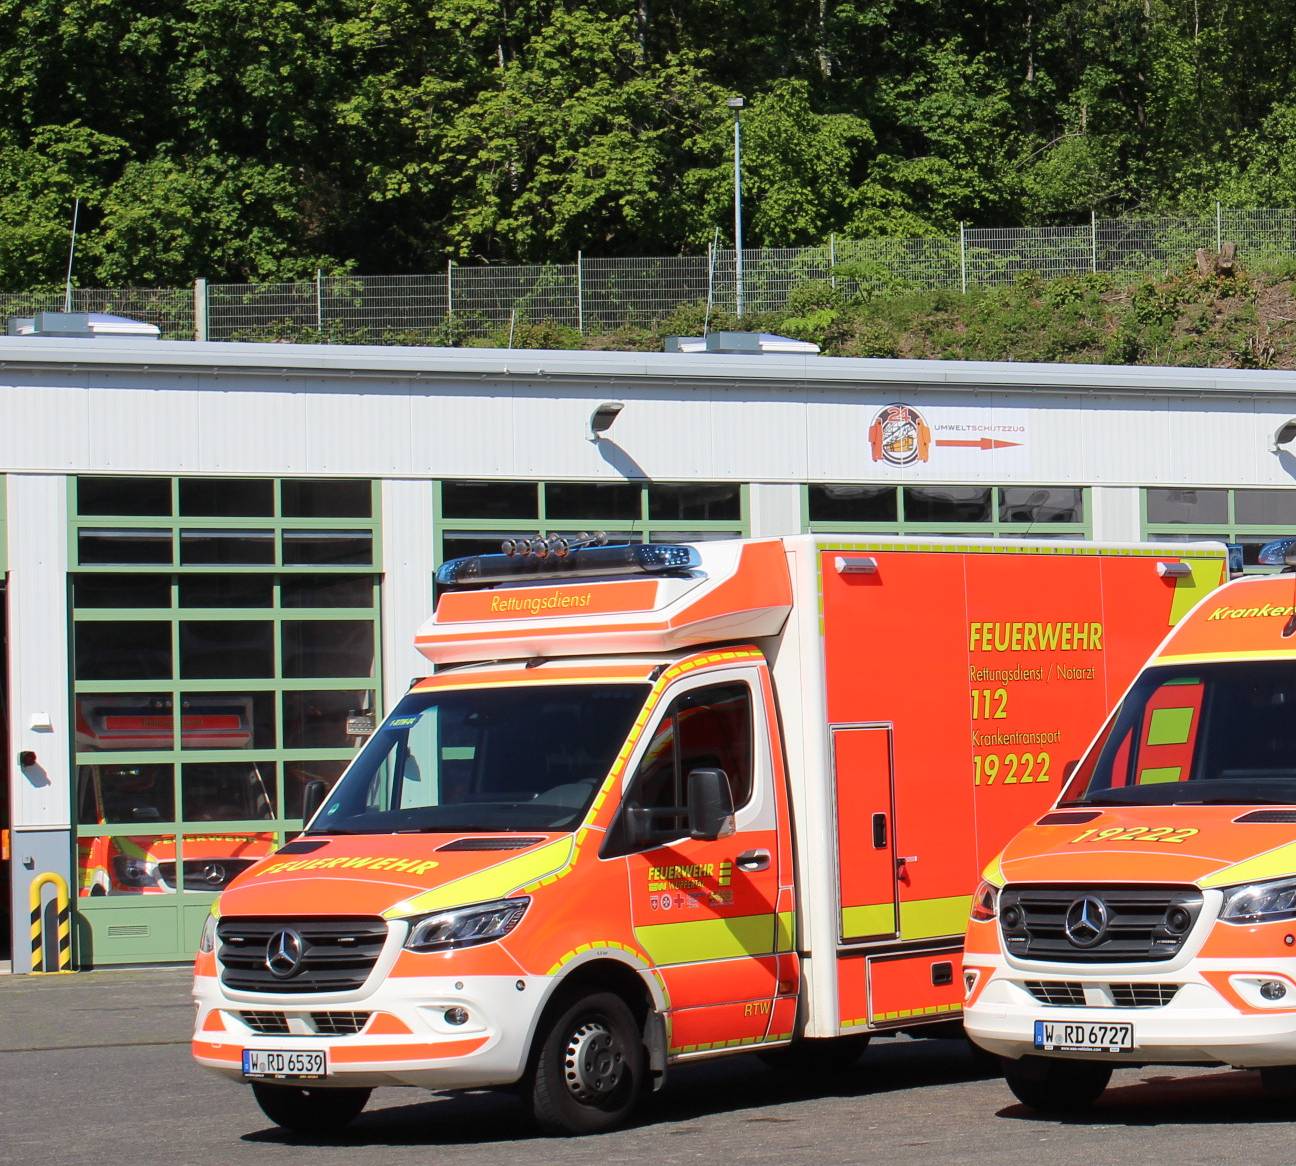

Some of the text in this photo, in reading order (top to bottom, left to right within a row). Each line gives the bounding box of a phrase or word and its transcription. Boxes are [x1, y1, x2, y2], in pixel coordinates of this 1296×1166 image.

[887, 407, 911, 422] 24
[491, 591, 592, 614] Rettungsdienst
[969, 622, 1103, 652] FEUERWEHR
[969, 664, 1043, 685] Rettungsdienst
[1056, 664, 1095, 680] Notarzt
[971, 688, 1008, 719] 112
[972, 729, 1061, 747] Krankentransport
[1070, 826, 1200, 843] 19222
[256, 857, 440, 876] FEUERWEHR
[648, 864, 714, 880] FEUERWEHR
[744, 1003, 770, 1016] RTW
[1045, 1024, 1054, 1043] W
[1065, 1025, 1085, 1044] RD
[1088, 1026, 1129, 1045] 6727
[251, 1053, 322, 1072] W RD 6539
